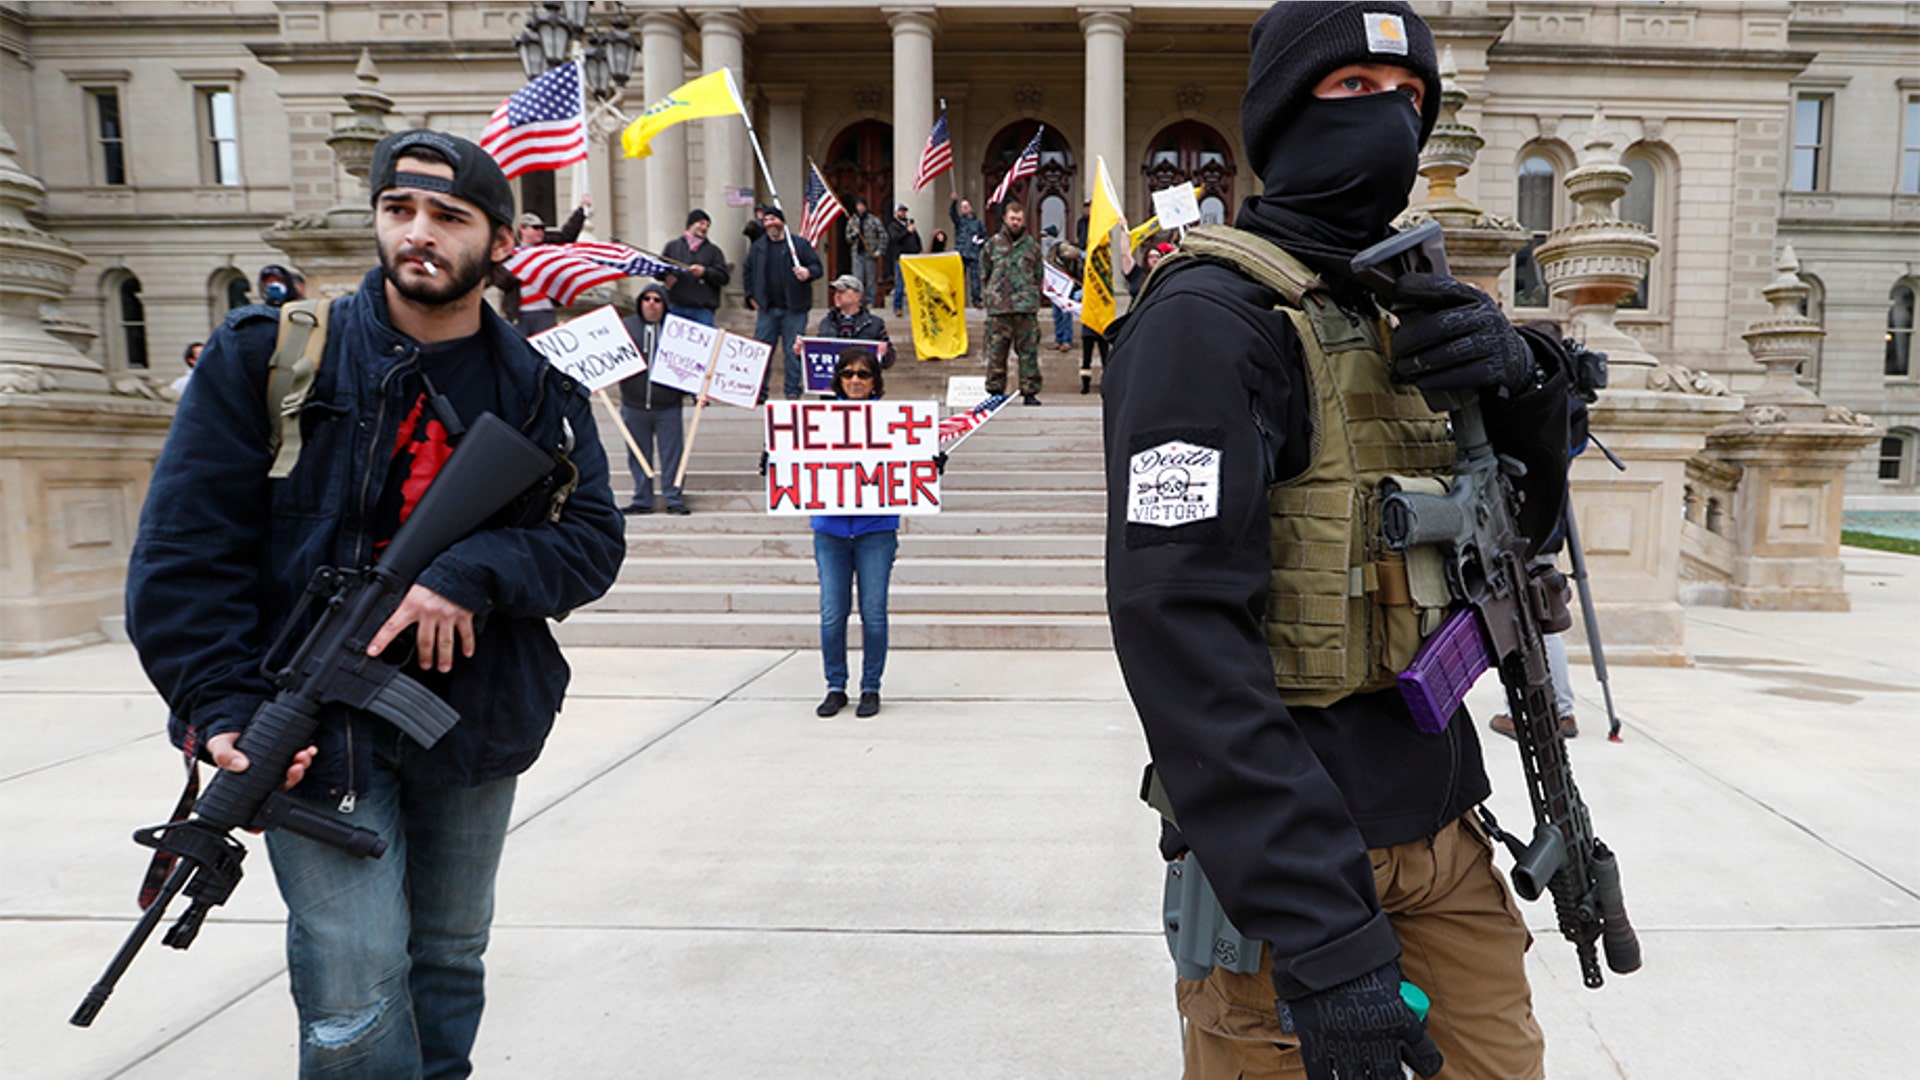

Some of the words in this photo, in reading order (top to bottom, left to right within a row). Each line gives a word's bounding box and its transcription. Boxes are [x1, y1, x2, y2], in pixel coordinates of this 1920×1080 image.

[537, 328, 579, 358] ND
[667, 320, 711, 348] OPEN
[564, 341, 639, 383] CKDOWN
[726, 340, 766, 361] STOP
[766, 404, 893, 451] HEIL
[1133, 449, 1216, 475] Death
[769, 461, 940, 510] WITMER
[1133, 503, 1210, 521] VICTORY
